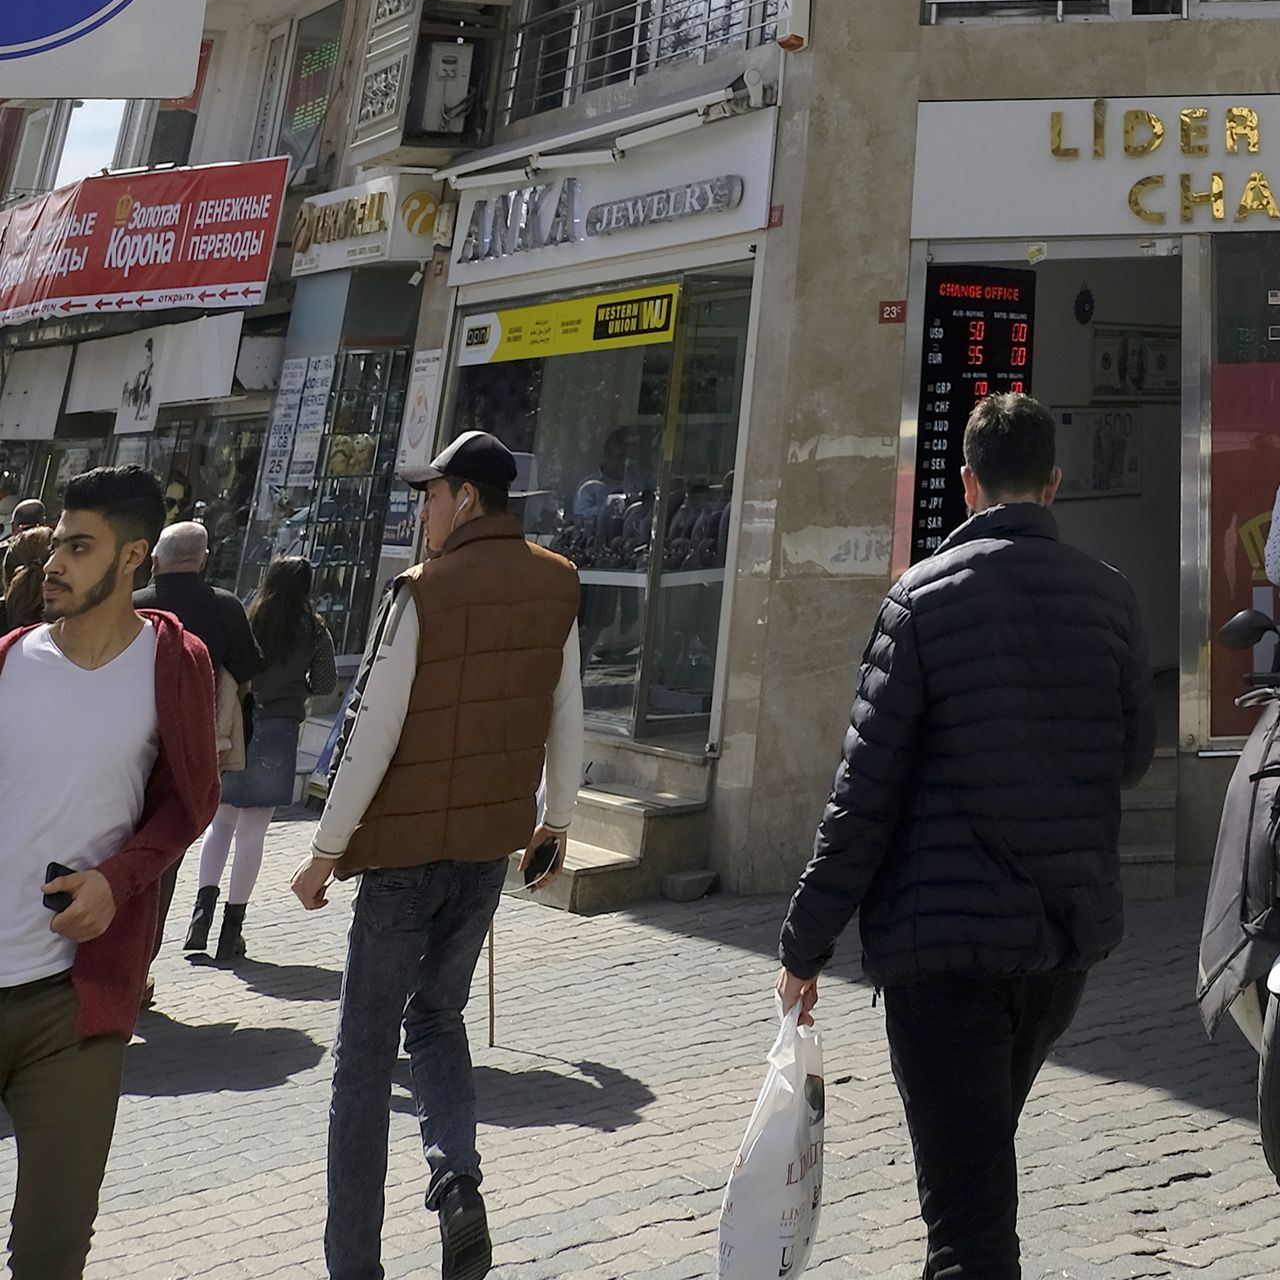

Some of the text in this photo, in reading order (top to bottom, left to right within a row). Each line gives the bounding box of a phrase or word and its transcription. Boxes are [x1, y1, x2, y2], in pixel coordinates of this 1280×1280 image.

[1050, 97, 1261, 161] LİDER
[127, 201, 182, 231] Золотая
[193, 193, 273, 229] ДЕНЕЖНЫЕ
[457, 177, 720, 264] ANKA JEWELRY
[103, 226, 177, 278] Корона
[187, 229, 265, 263] ПЕРЕВОДЫ
[939, 283, 1020, 301] CHANGE OFFICE
[597, 302, 639, 321] WESTERN
[608, 317, 637, 335] UNION
[929, 327, 944, 339] USD
[928, 352, 942, 364] EUR
[936, 382, 952, 394] GBP
[934, 401, 950, 413] CHF
[933, 420, 949, 432] AUD
[932, 439, 948, 451] CAD
[268, 460, 283, 474] 25
[931, 458, 946, 470] SEK
[930, 477, 945, 490] DKK
[928, 496, 943, 509] JPY
[927, 517, 942, 529] SAR
